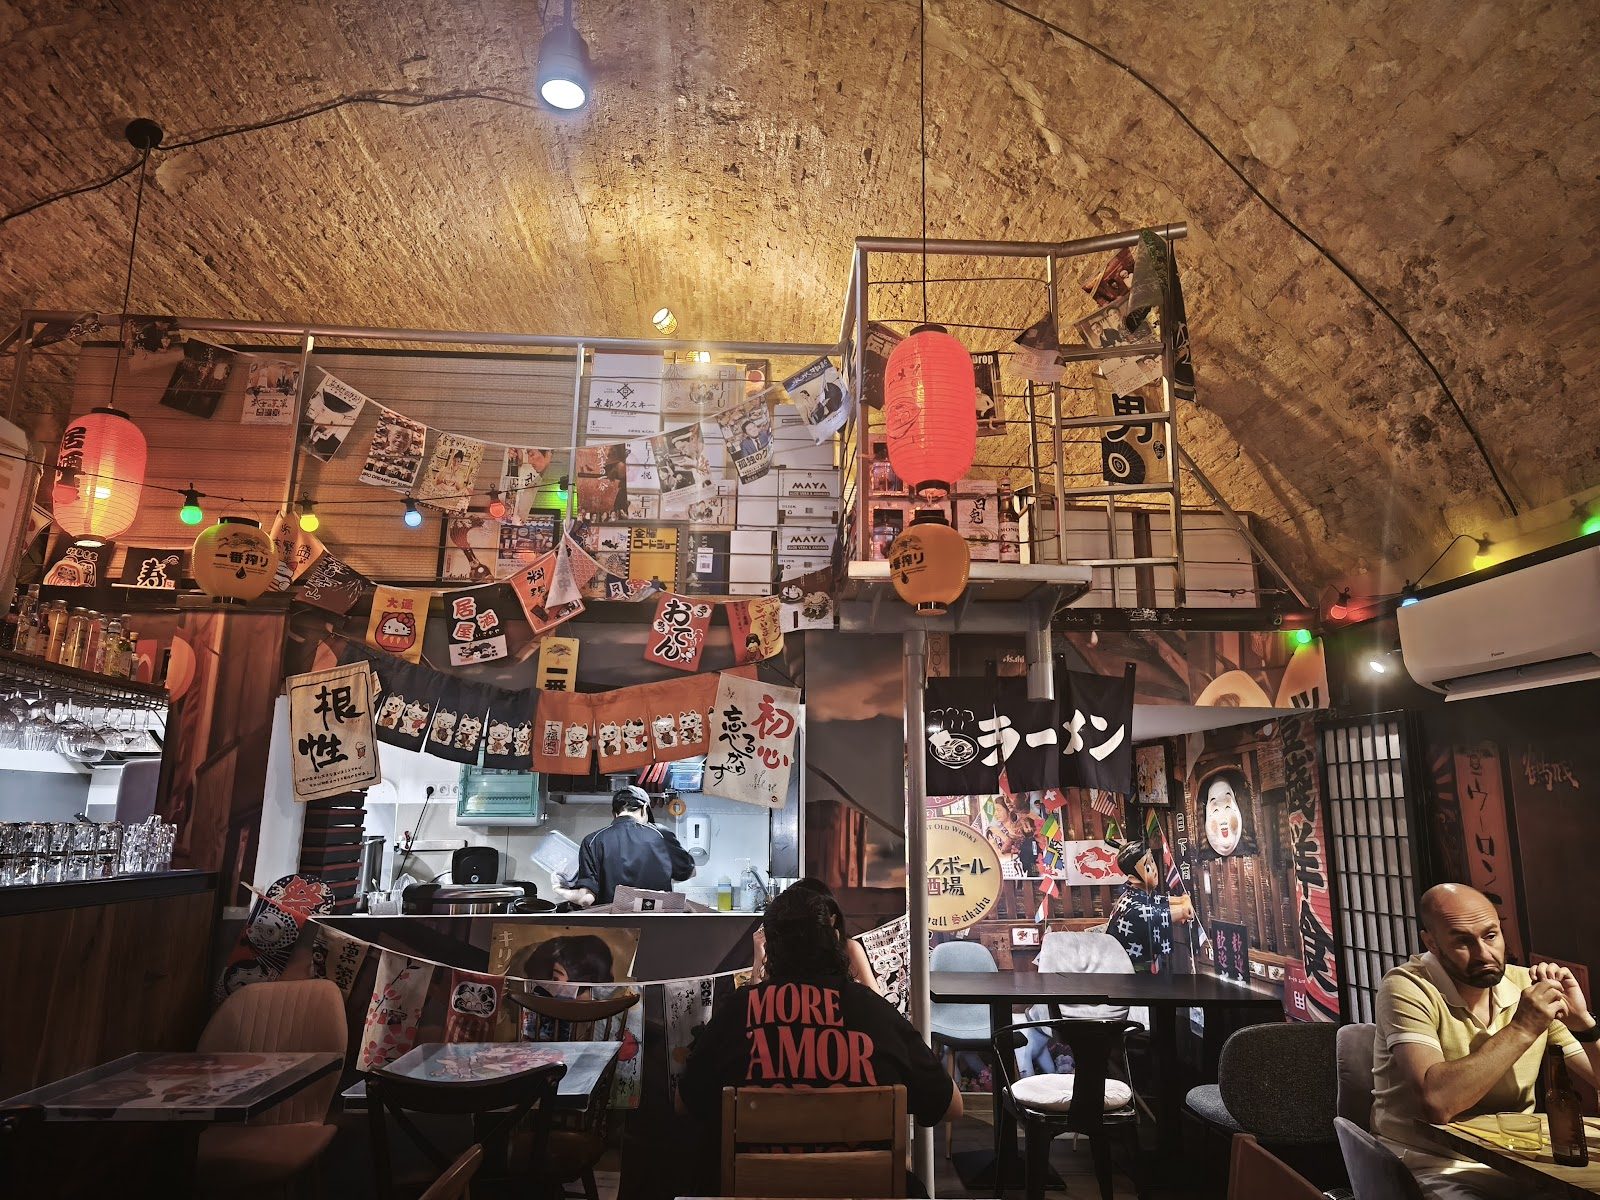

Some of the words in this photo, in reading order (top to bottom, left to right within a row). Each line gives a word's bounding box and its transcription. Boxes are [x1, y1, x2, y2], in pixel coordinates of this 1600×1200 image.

[593, 398, 656, 408] 京都ウイスキー
[215, 552, 268, 567] 一番搾り
[654, 598, 692, 661] おでん
[298, 686, 366, 773] 根性
[751, 694, 795, 770] 初心
[977, 709, 1125, 766] ラーメン
[927, 856, 991, 876] イボール
[746, 983, 844, 1027] MORE
[745, 1026, 876, 1086] AMOR
